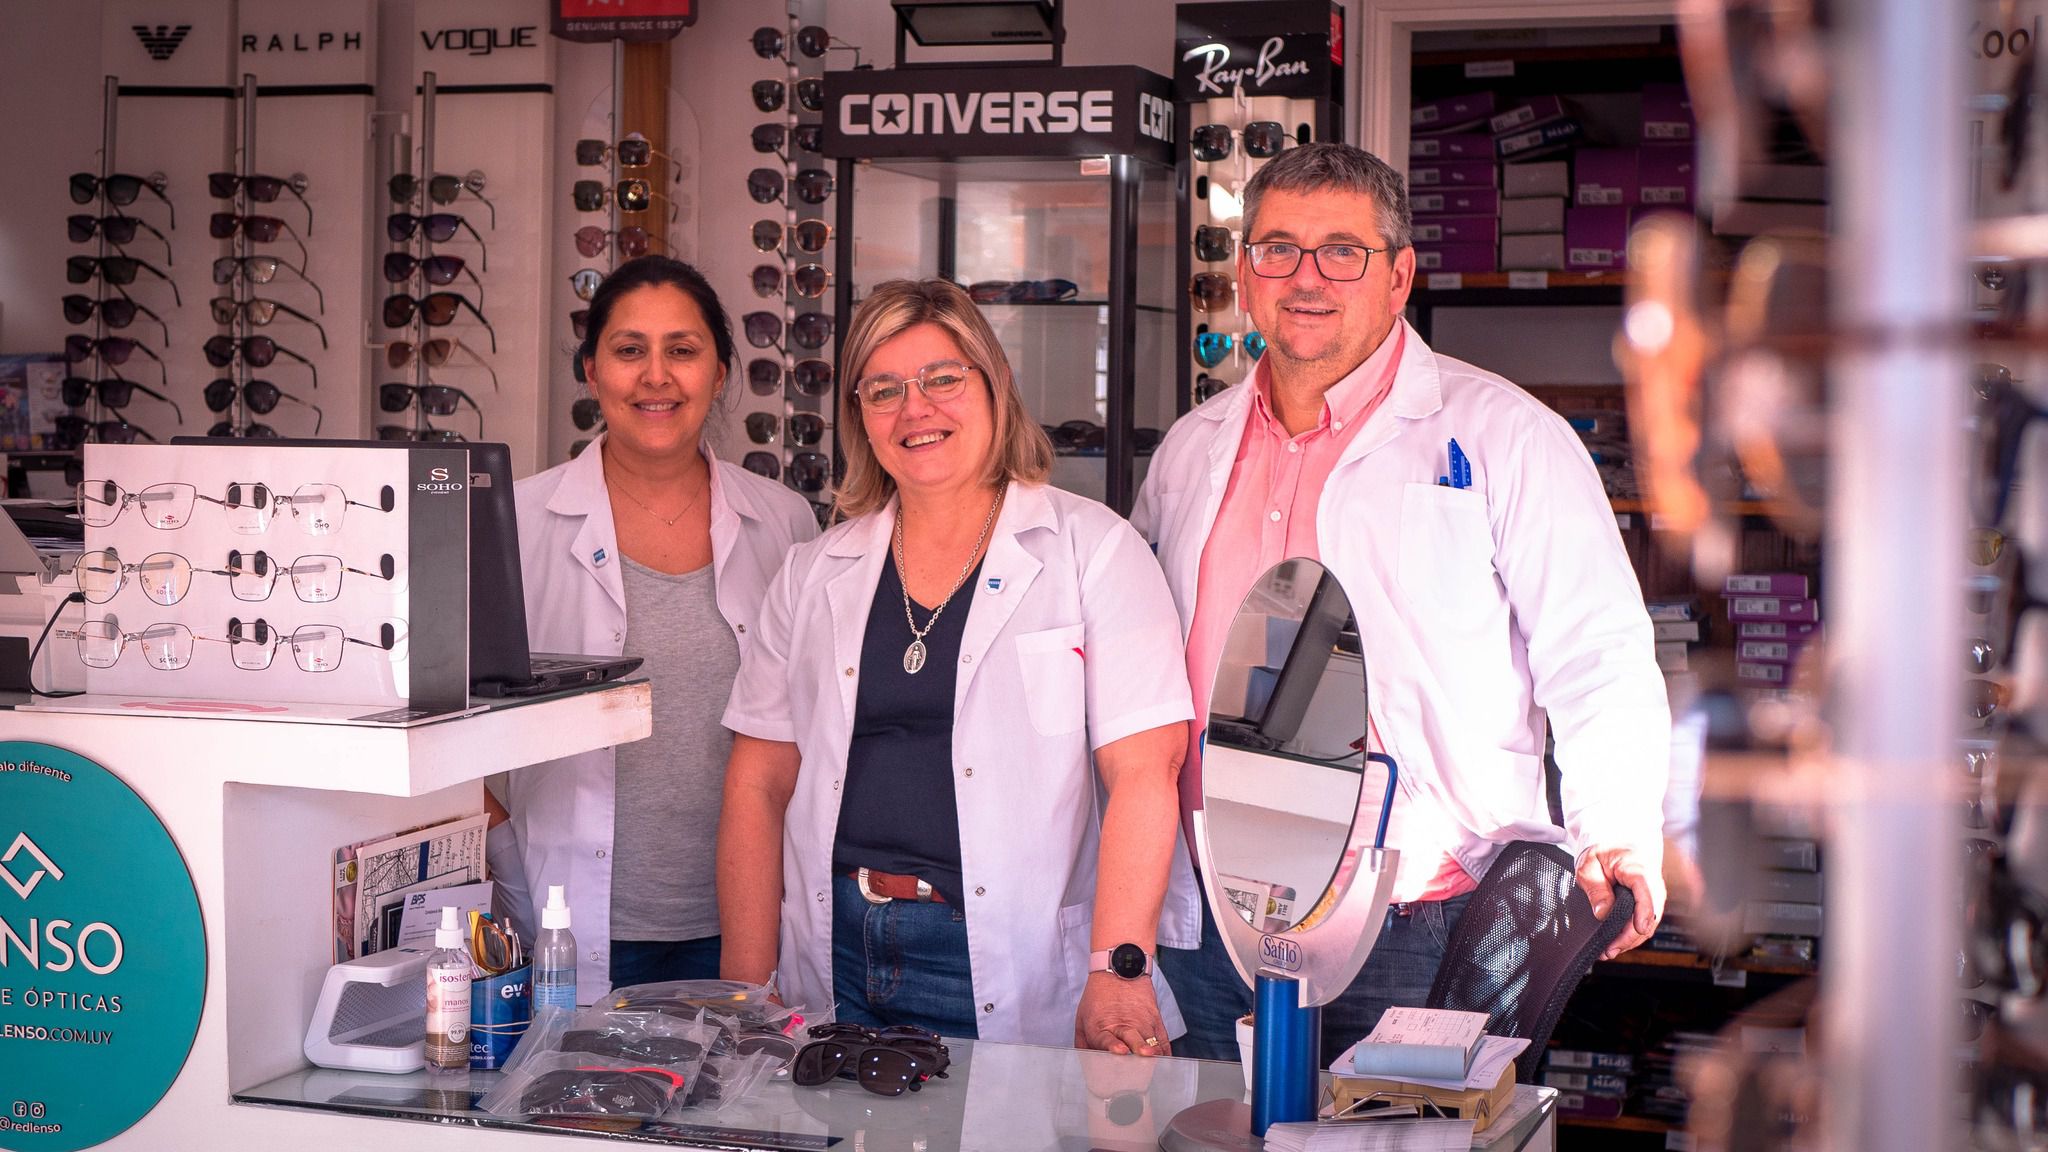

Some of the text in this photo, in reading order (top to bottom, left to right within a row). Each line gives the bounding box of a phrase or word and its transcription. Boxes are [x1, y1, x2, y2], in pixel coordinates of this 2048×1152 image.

[566, 22, 616, 31] GENUINE
[620, 21, 653, 30] SINCE
[241, 32, 361, 52] RALPH
[420, 26, 537, 55] VOGUE
[840, 91, 1113, 135] CONVERSE
[417, 483, 463, 491] SOHO
[18, 762, 71, 782] diferente
[410, 893, 426, 906] BPS
[24, 986, 122, 1013] ÓPTICAS
[0, 1116, 61, 1133] @redlenso
